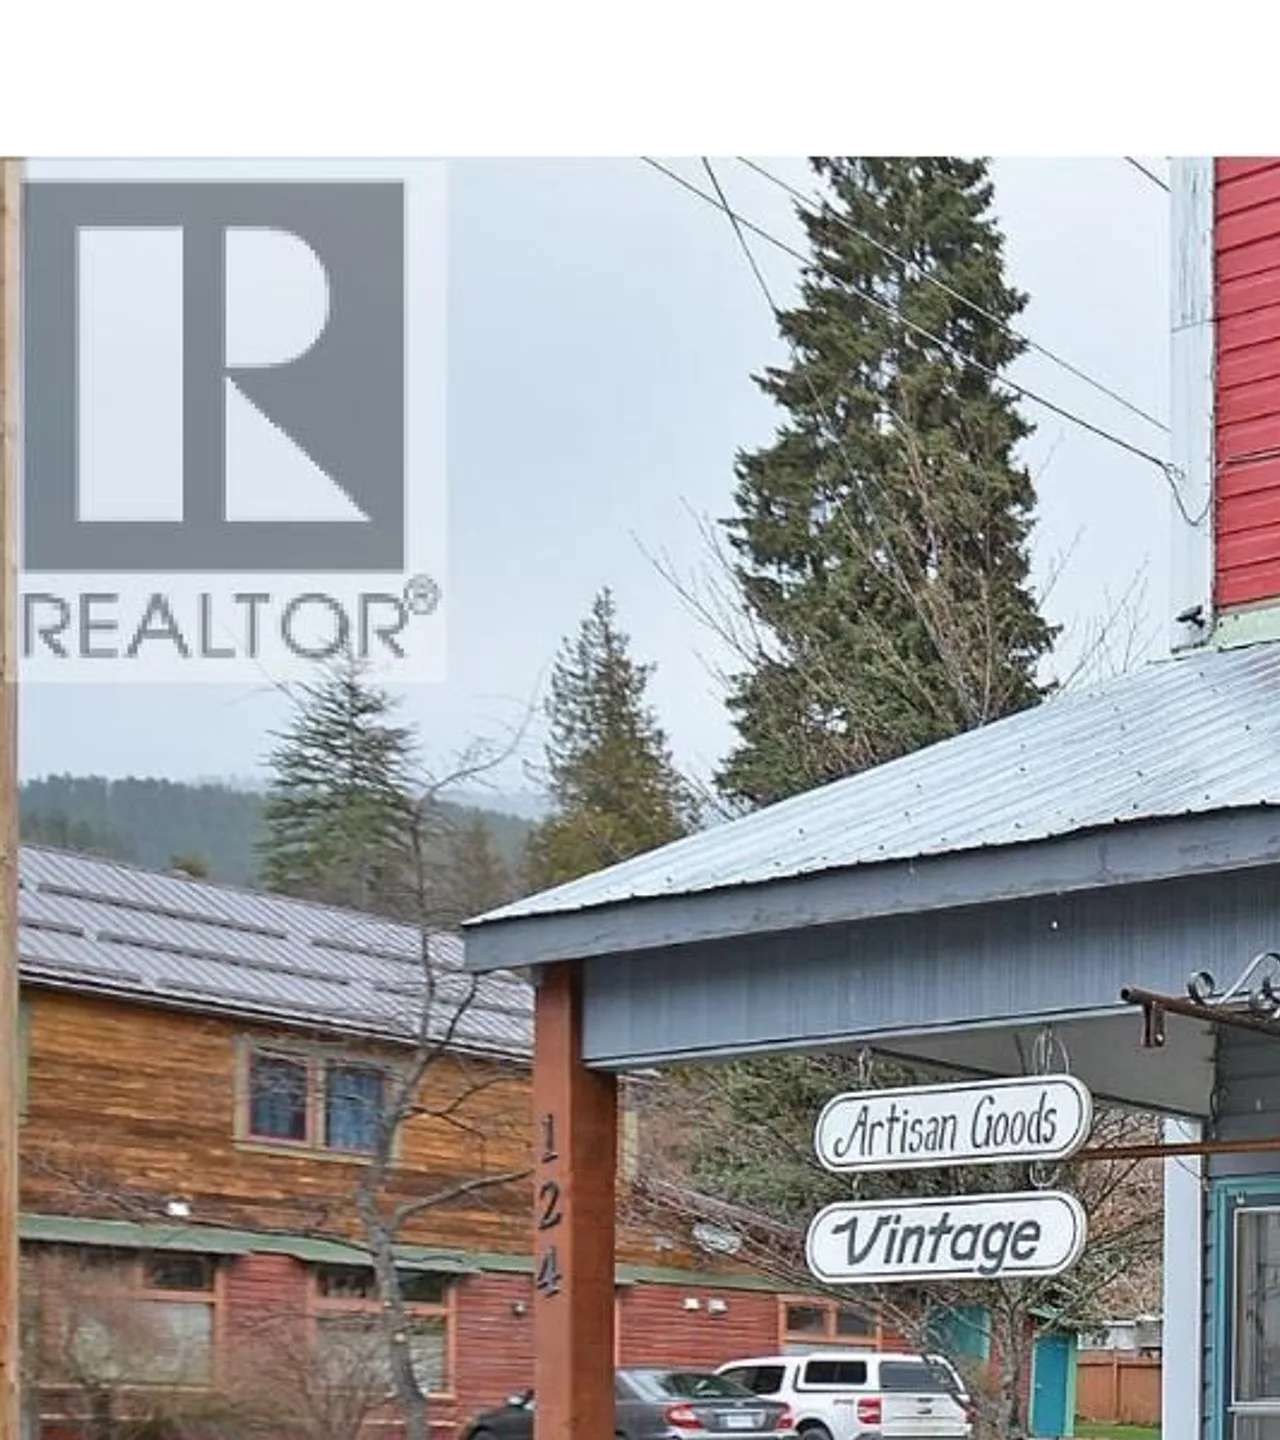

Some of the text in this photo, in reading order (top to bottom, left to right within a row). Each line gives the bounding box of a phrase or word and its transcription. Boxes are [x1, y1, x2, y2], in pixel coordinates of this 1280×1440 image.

[833, 1091, 1058, 1158] Artisan Goods
[537, 1113, 563, 1298] 124
[831, 1211, 1041, 1275] Vintage
